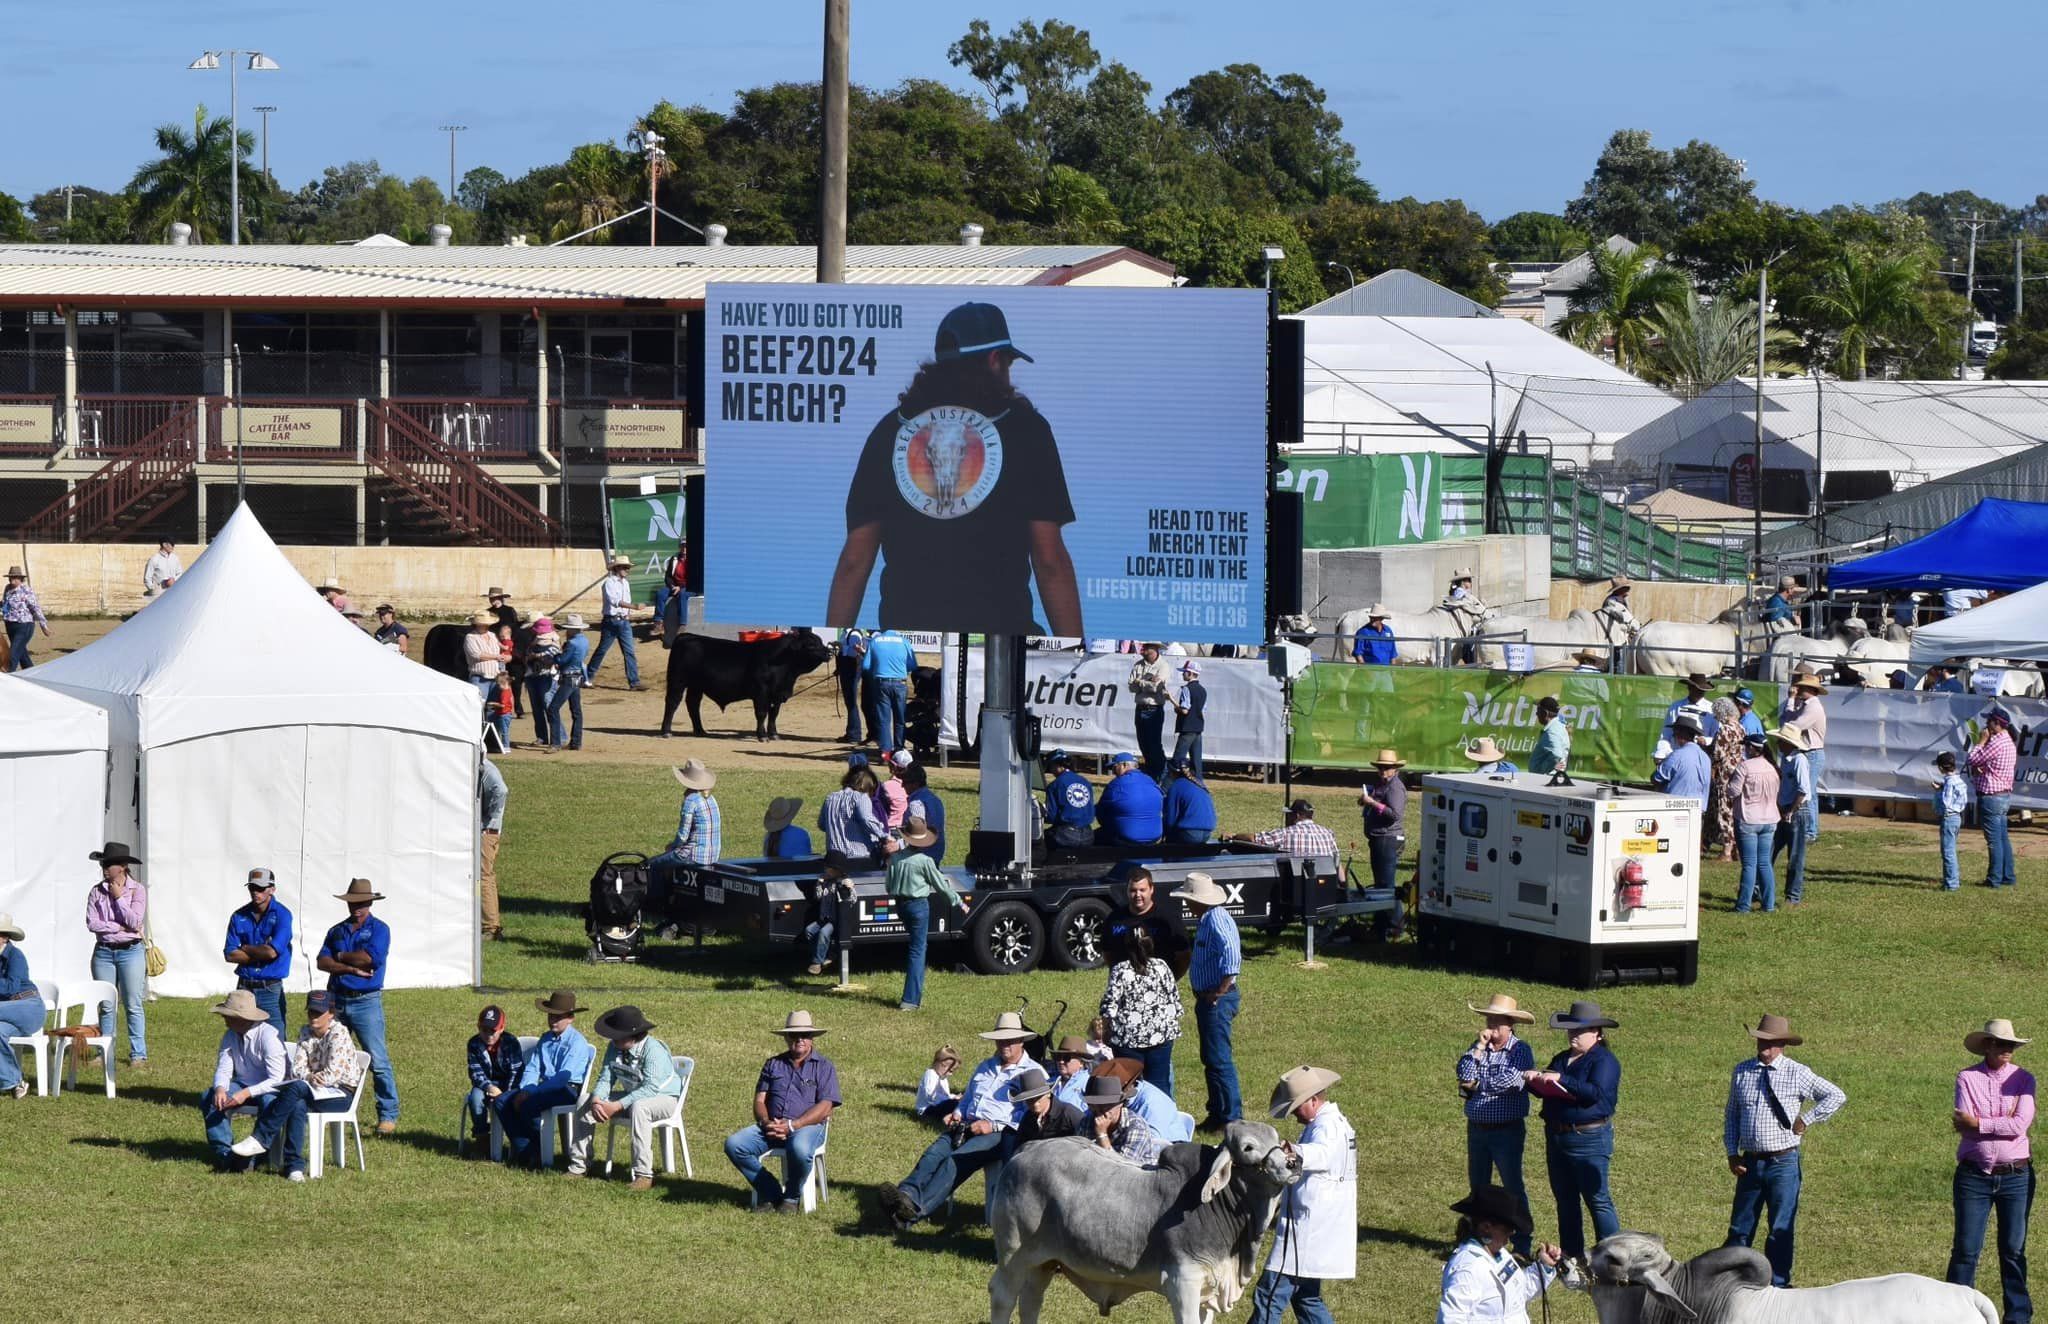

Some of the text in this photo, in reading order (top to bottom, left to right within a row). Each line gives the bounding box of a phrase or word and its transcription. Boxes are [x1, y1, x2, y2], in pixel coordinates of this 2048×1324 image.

[721, 302, 903, 329] HAVE YOU GOT YOUR
[722, 334, 877, 376] BEEF2024
[722, 381, 847, 423] MERCH?
[248, 422, 312, 433] CATTLEMANS
[273, 414, 290, 423] THE
[620, 424, 666, 432] NORTHERN
[930, 409, 998, 449] AUSTRALIA
[271, 432, 291, 441] BAR
[922, 497, 969, 516] 2024
[1149, 509, 1248, 533] HEAD TO THE
[1149, 533, 1248, 557] MERCH TENT
[1126, 556, 1248, 580] LOCATED IN THE
[1087, 578, 1248, 604] LIFESTYLE PRECINCT
[1167, 604, 1201, 627] SITE
[1460, 691, 1600, 730] Nutren
[1565, 813, 1587, 838] CAT
[1636, 819, 1654, 833] CAT
